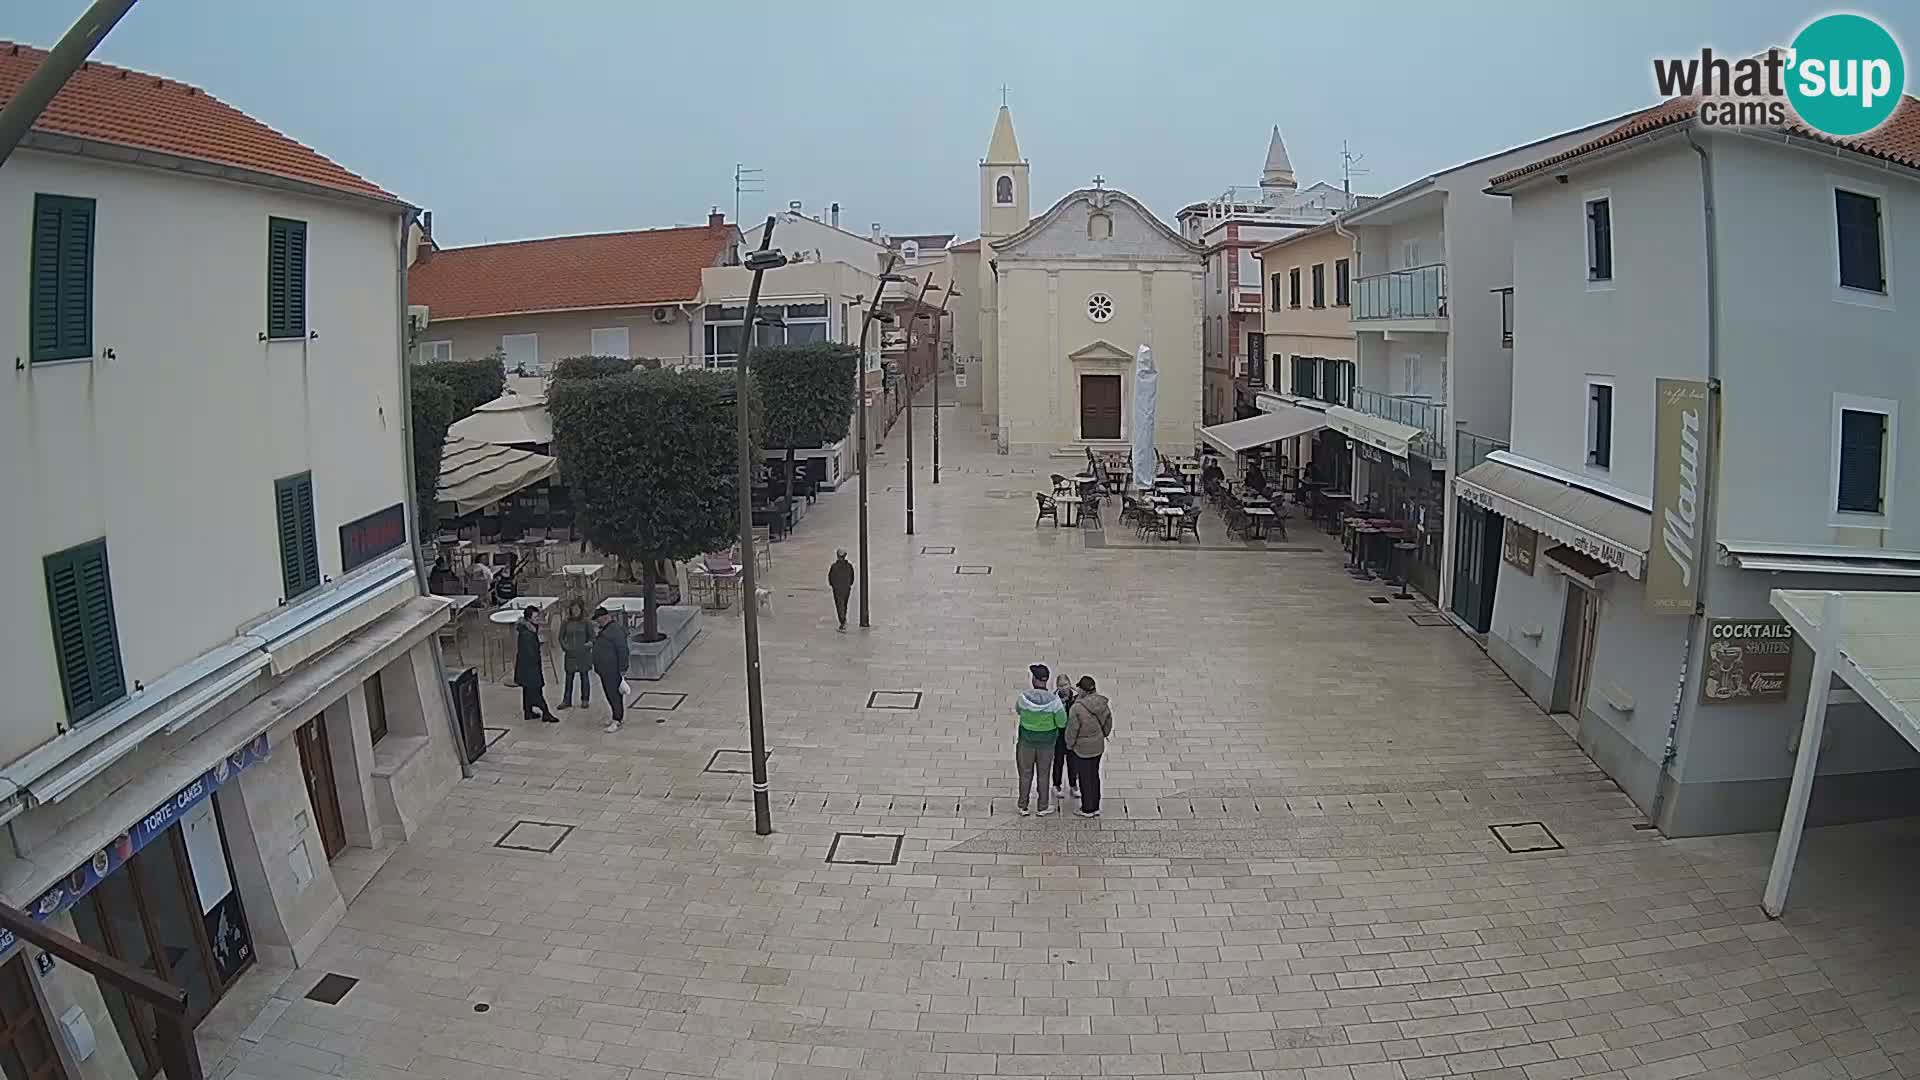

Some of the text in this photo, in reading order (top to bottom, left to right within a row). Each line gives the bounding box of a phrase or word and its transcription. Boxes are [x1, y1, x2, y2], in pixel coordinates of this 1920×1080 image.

[1712, 624, 1792, 638] COCKTAILS
[143, 803, 172, 833] TORTE
[177, 780, 203, 809] CAKES
